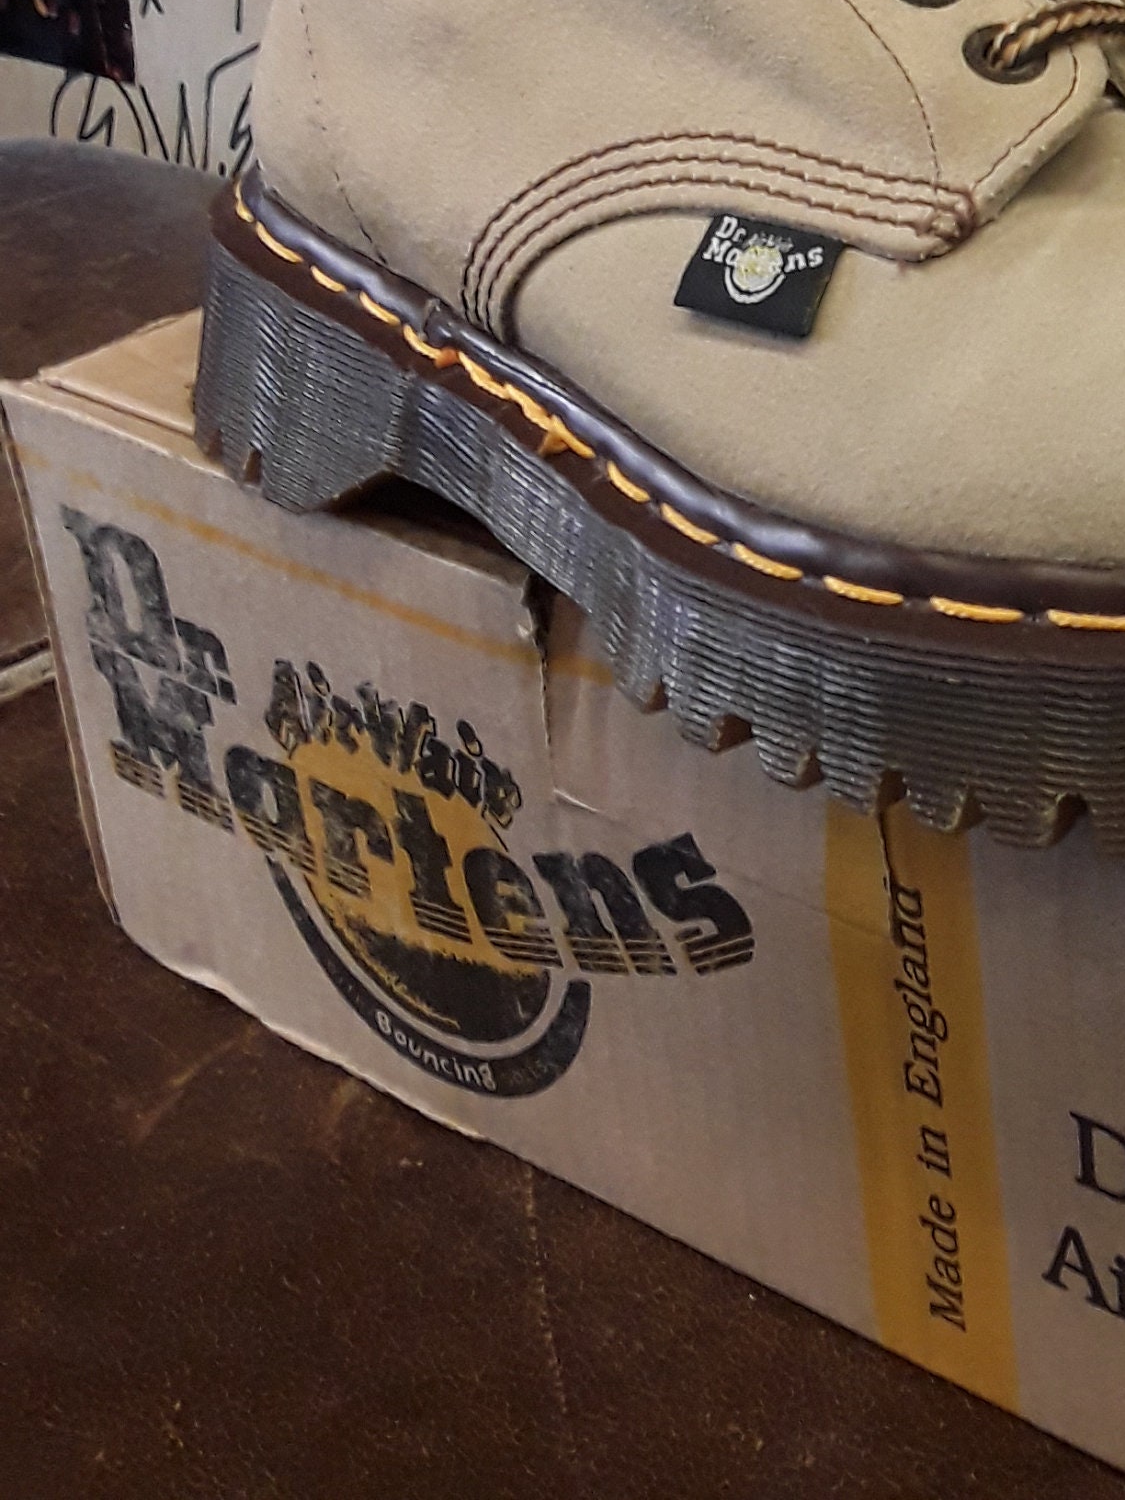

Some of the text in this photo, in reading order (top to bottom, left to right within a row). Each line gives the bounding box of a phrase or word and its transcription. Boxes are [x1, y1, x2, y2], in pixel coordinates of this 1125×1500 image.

[89, 633, 756, 979] Martens
[374, 1009, 498, 1092] Bouncing
[886, 878, 968, 1333] Made in England
